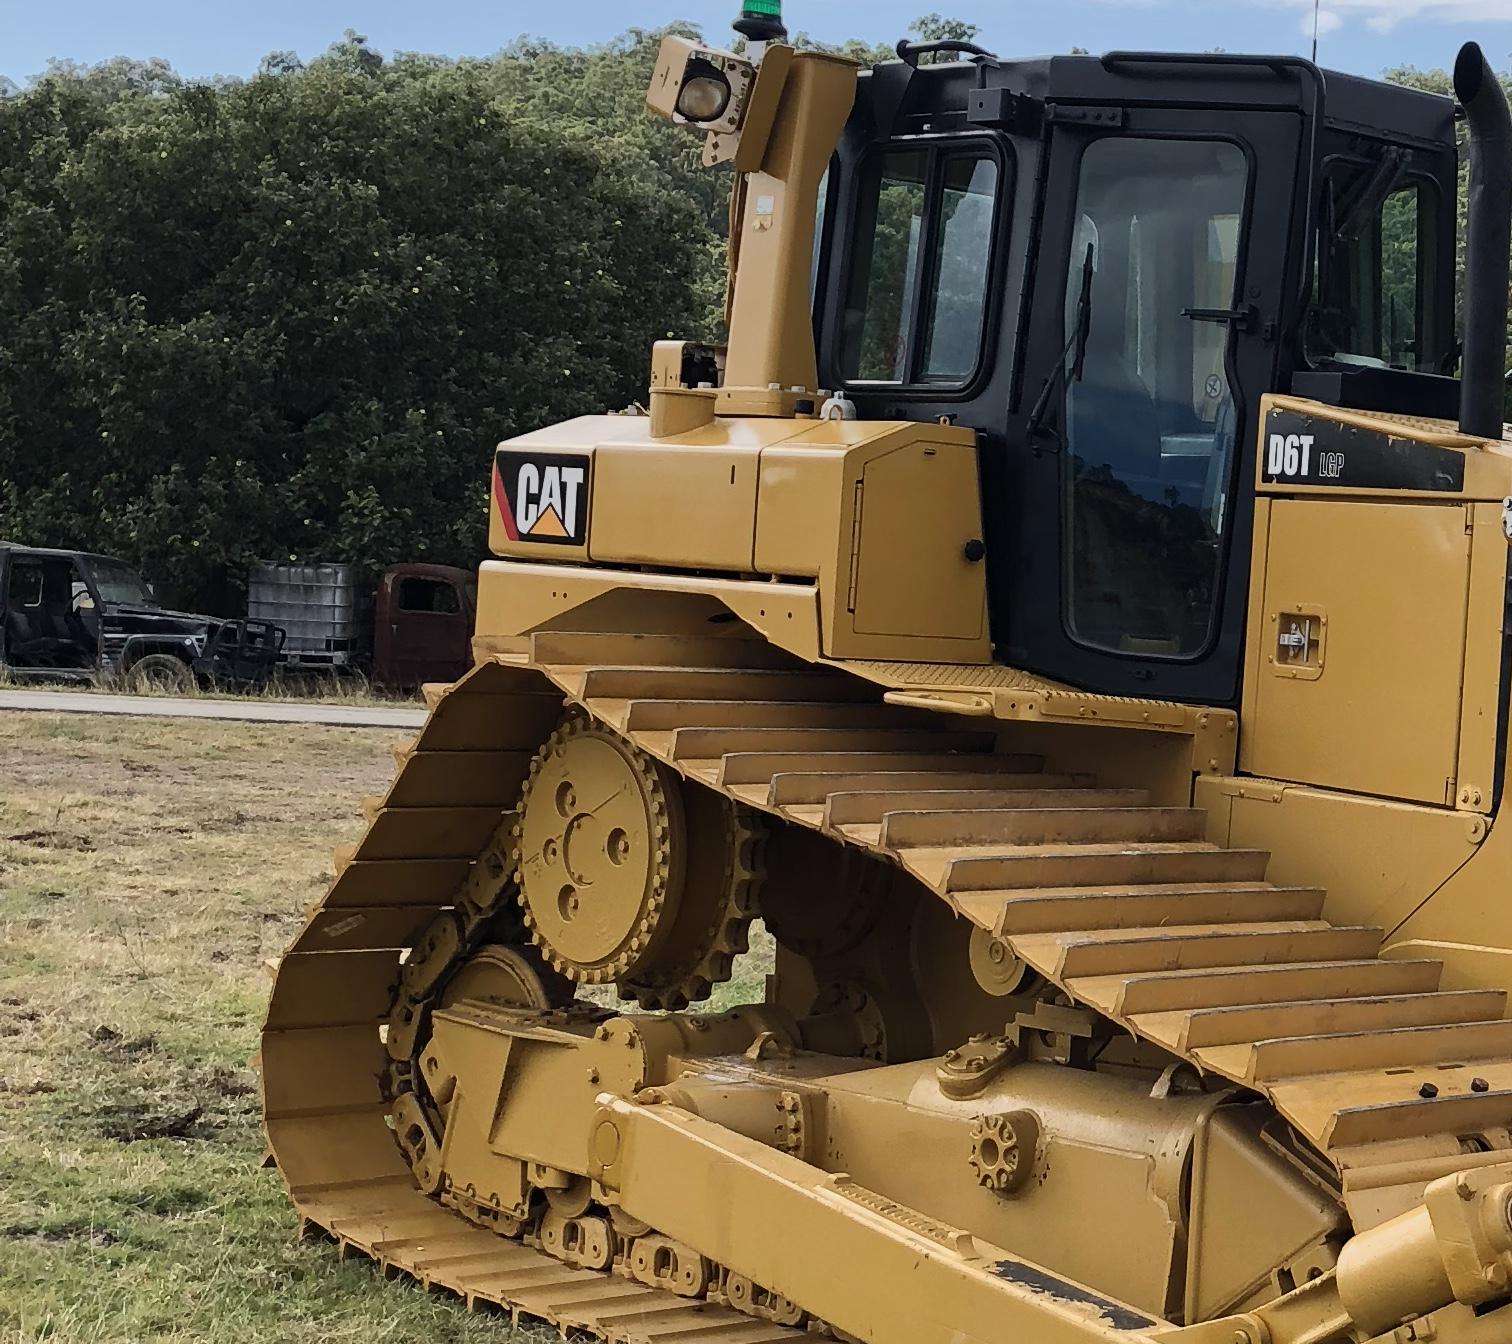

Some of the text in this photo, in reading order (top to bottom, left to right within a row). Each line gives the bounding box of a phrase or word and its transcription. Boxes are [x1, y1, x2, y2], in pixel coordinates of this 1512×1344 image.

[1268, 435, 1345, 478] D6T LGP
[516, 462, 584, 538] CAT
